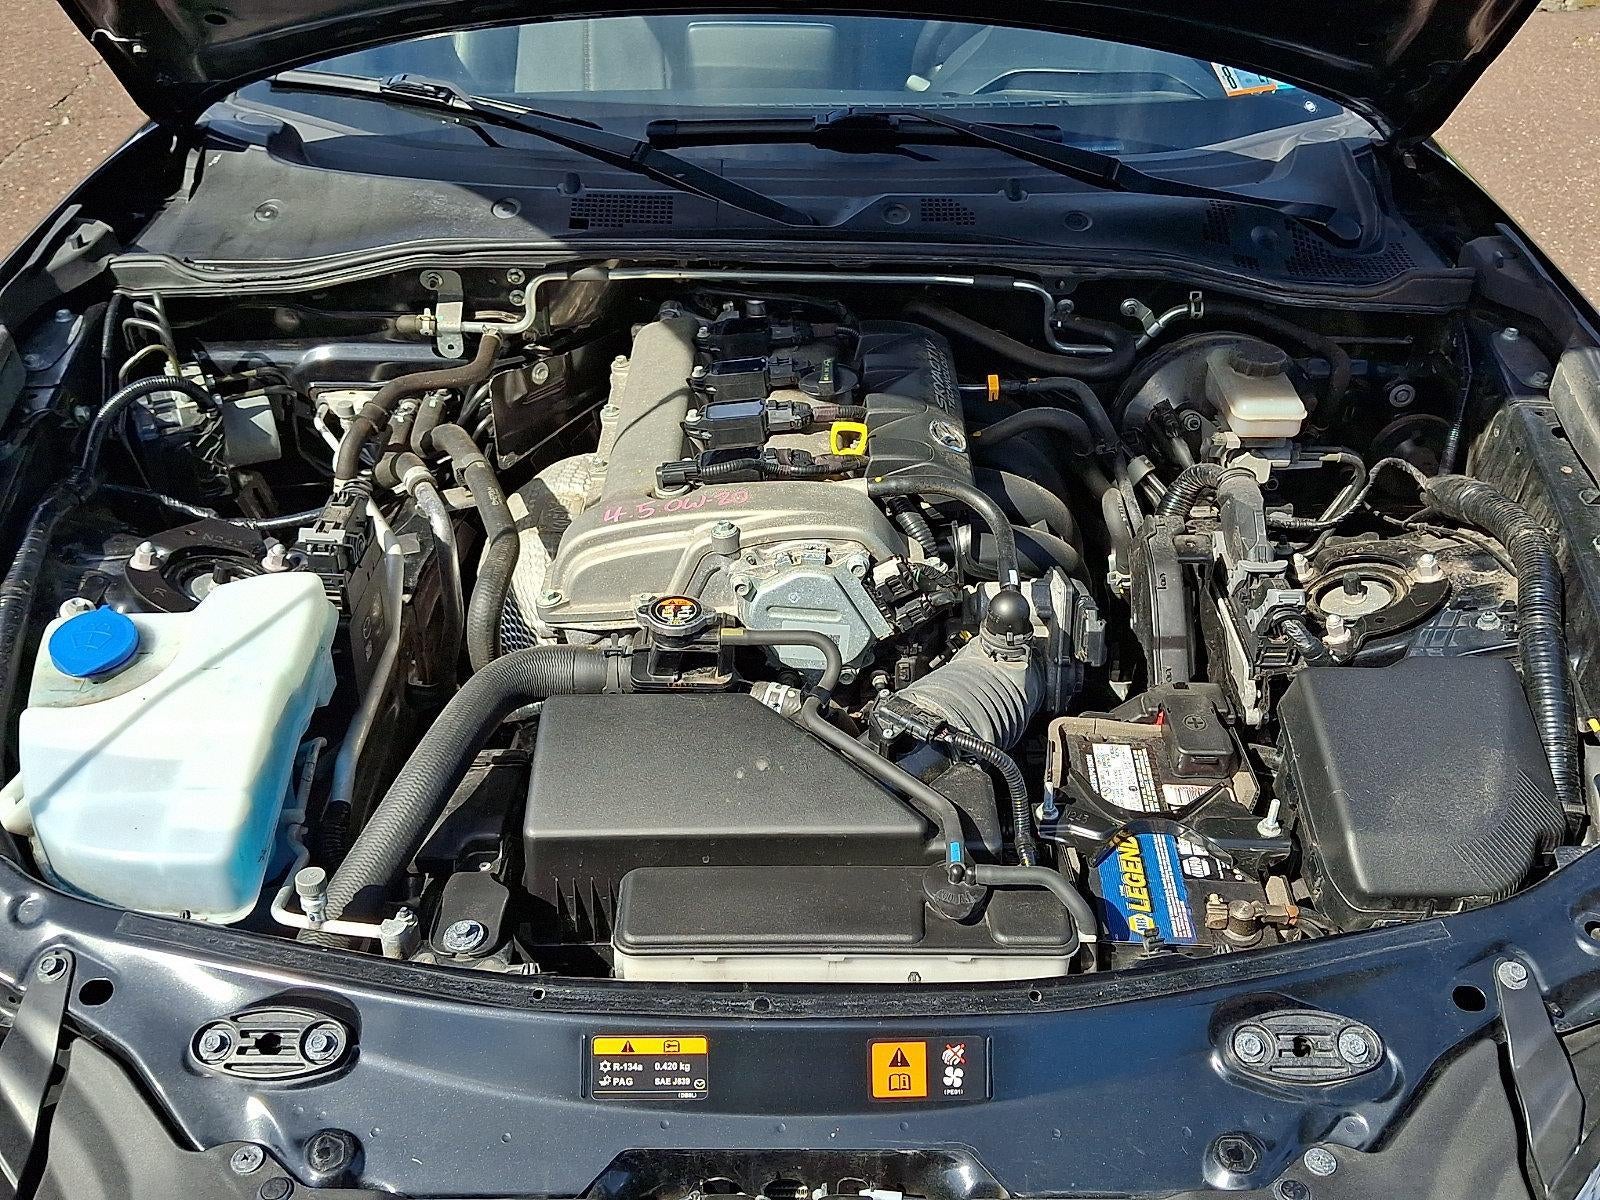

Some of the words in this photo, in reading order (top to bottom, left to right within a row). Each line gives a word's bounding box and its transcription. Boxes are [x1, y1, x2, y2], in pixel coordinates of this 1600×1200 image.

[925, 339, 951, 415] SKYACTIV
[612, 1062, 643, 1072] R-134a
[654, 1061, 678, 1071] 0.420
[679, 1061, 691, 1073] kg
[612, 1077, 634, 1087] PAG
[654, 1077, 672, 1086] SAE
